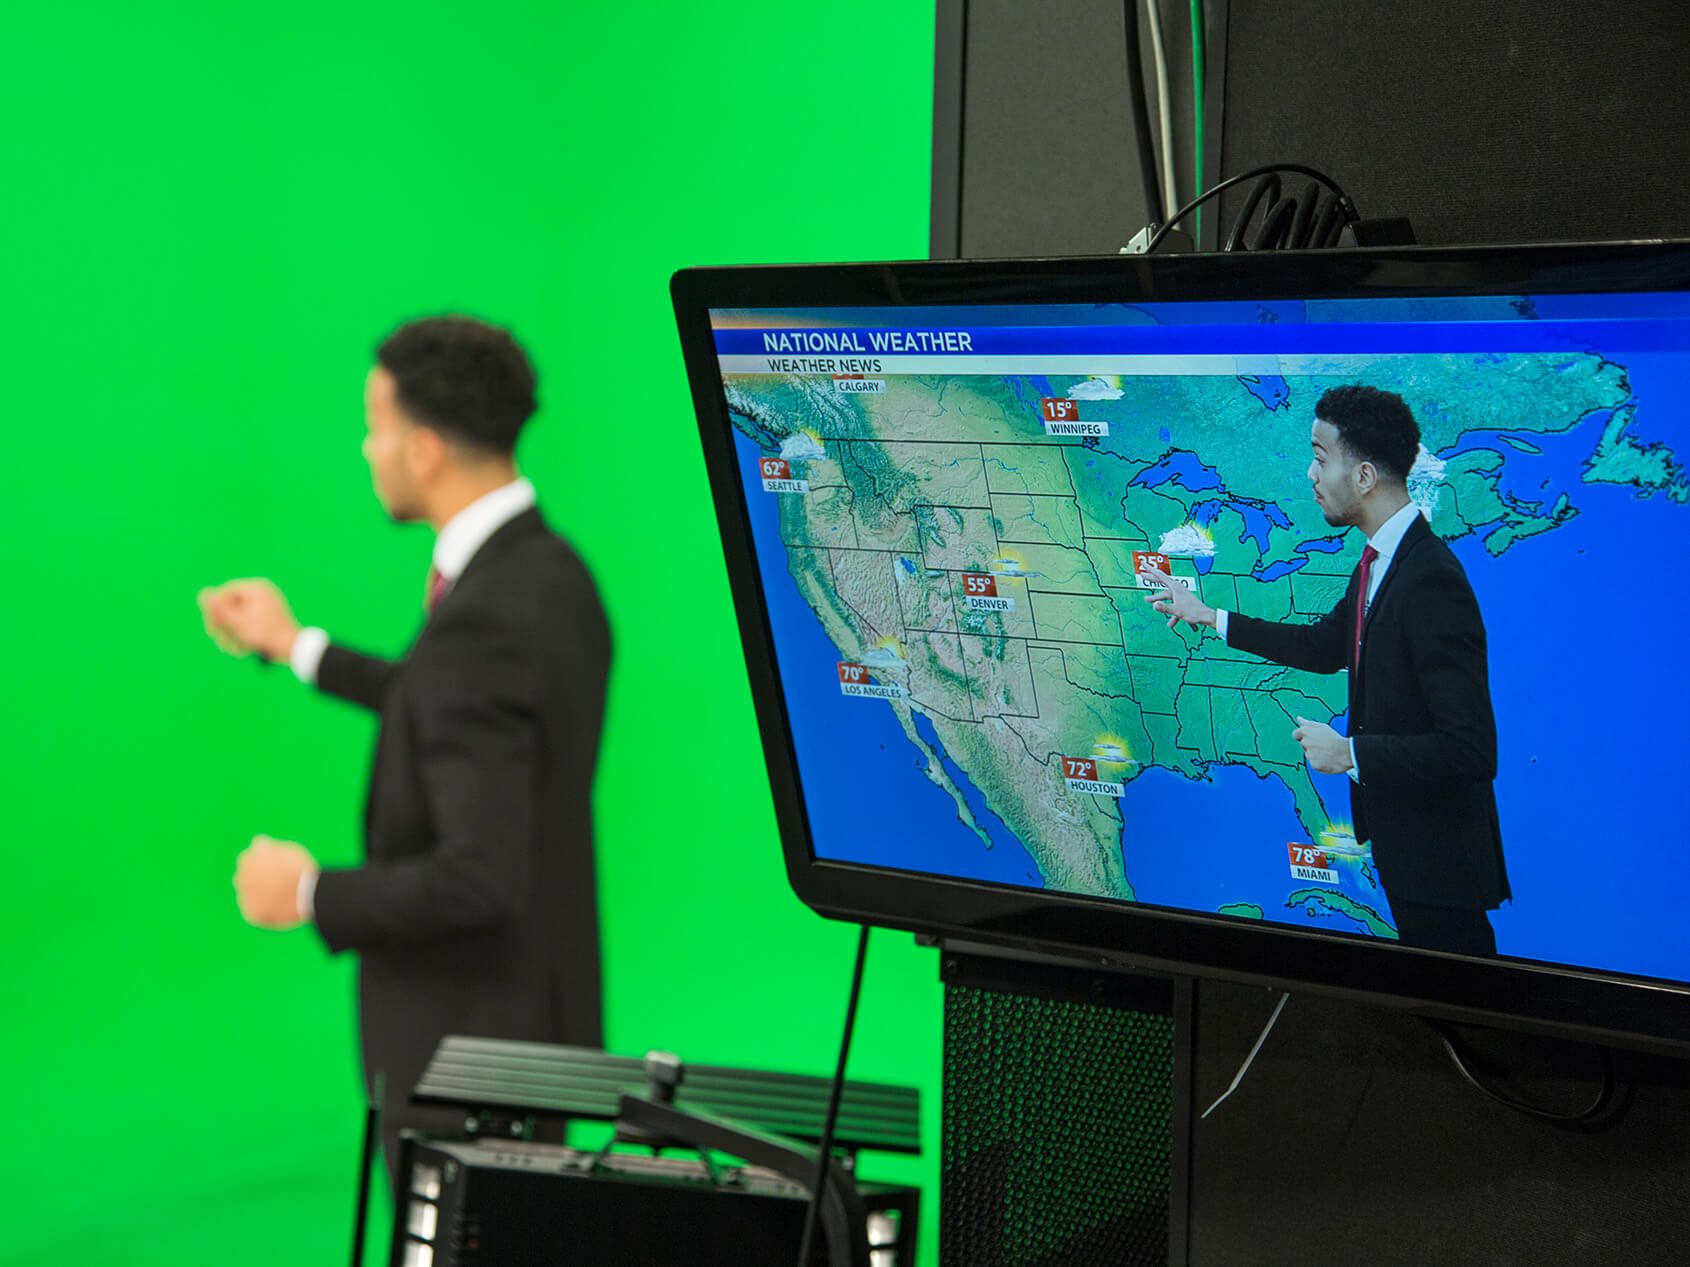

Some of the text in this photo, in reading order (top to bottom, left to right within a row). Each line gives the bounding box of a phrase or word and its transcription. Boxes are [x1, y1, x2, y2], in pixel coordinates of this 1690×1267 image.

[763, 331, 973, 352] NATIONAL WEATHER
[768, 359, 882, 373] WEATHER NEWS
[839, 382, 879, 392] CALGARY
[1047, 401, 1072, 418] 15°
[1051, 423, 1101, 434] WINNIPEG
[763, 461, 785, 476] 62°
[768, 481, 803, 491] SEATTLE
[967, 577, 992, 593] 55°
[971, 598, 1009, 610] DENVER
[841, 665, 865, 681] 70°
[845, 685, 902, 699] LOS ANGELES
[1067, 760, 1092, 777] 72°
[1071, 781, 1119, 795] HOUSTON
[1292, 847, 1321, 865] 78°
[1297, 867, 1331, 881] MIAMI
